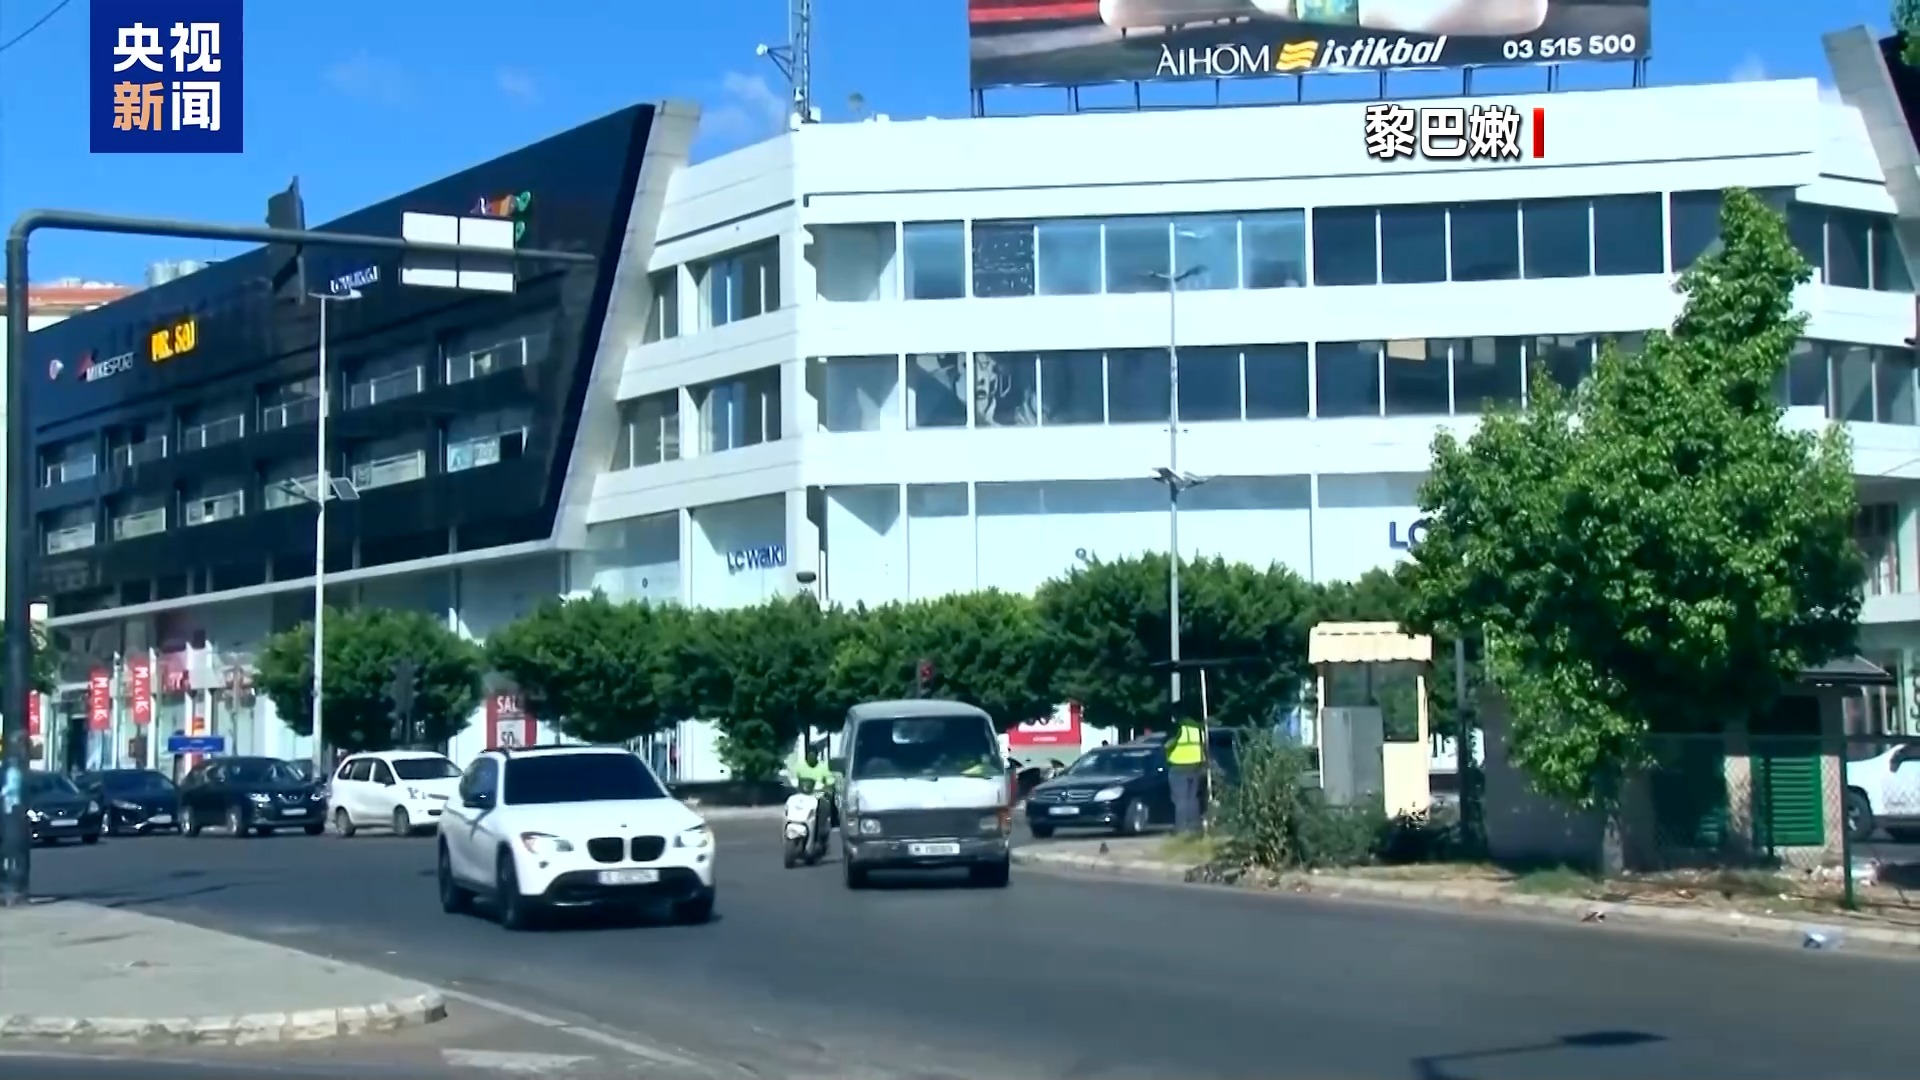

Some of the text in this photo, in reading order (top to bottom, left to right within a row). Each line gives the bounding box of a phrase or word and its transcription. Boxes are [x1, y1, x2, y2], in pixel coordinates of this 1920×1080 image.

[1319, 35, 1448, 68] istikbal
[1503, 34, 1636, 60] 03 515 500
